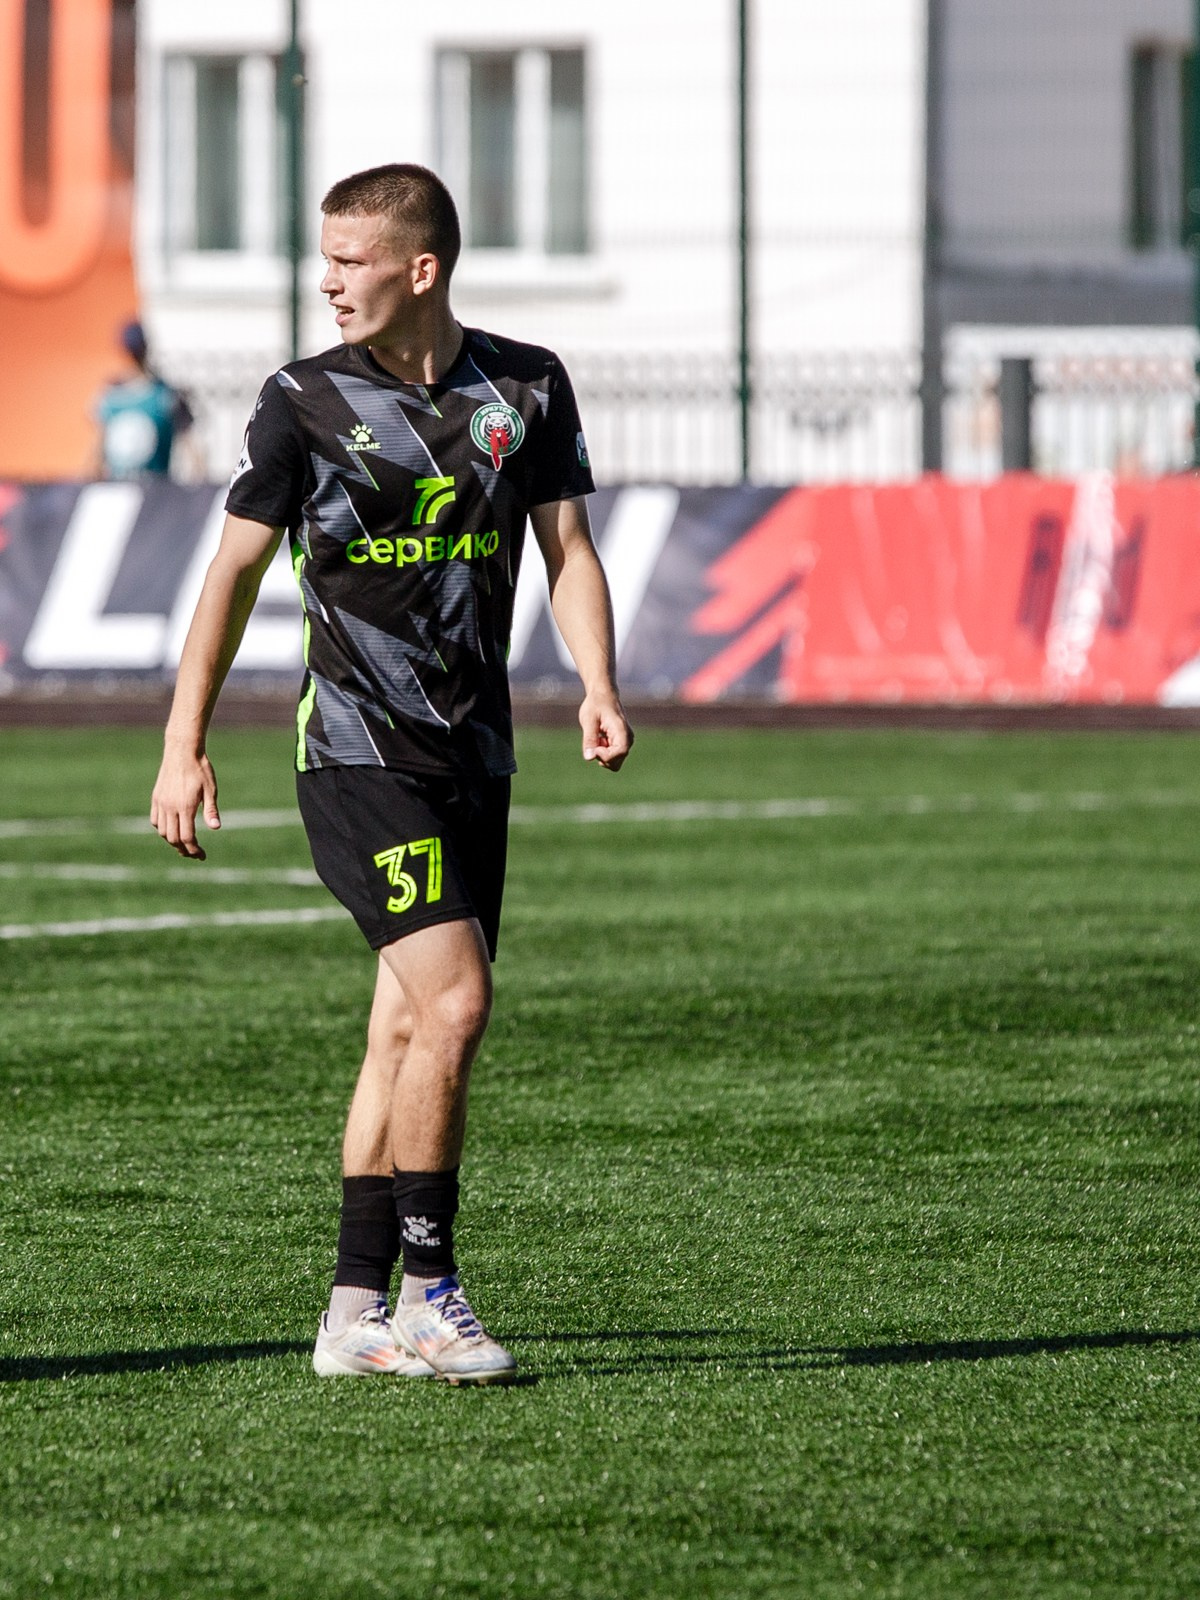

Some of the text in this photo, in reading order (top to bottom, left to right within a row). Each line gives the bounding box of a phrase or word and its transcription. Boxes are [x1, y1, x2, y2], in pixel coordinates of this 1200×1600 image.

[345, 442, 381, 452] KELME
[24, 482, 680, 671] LEN
[373, 836, 443, 914] 37
